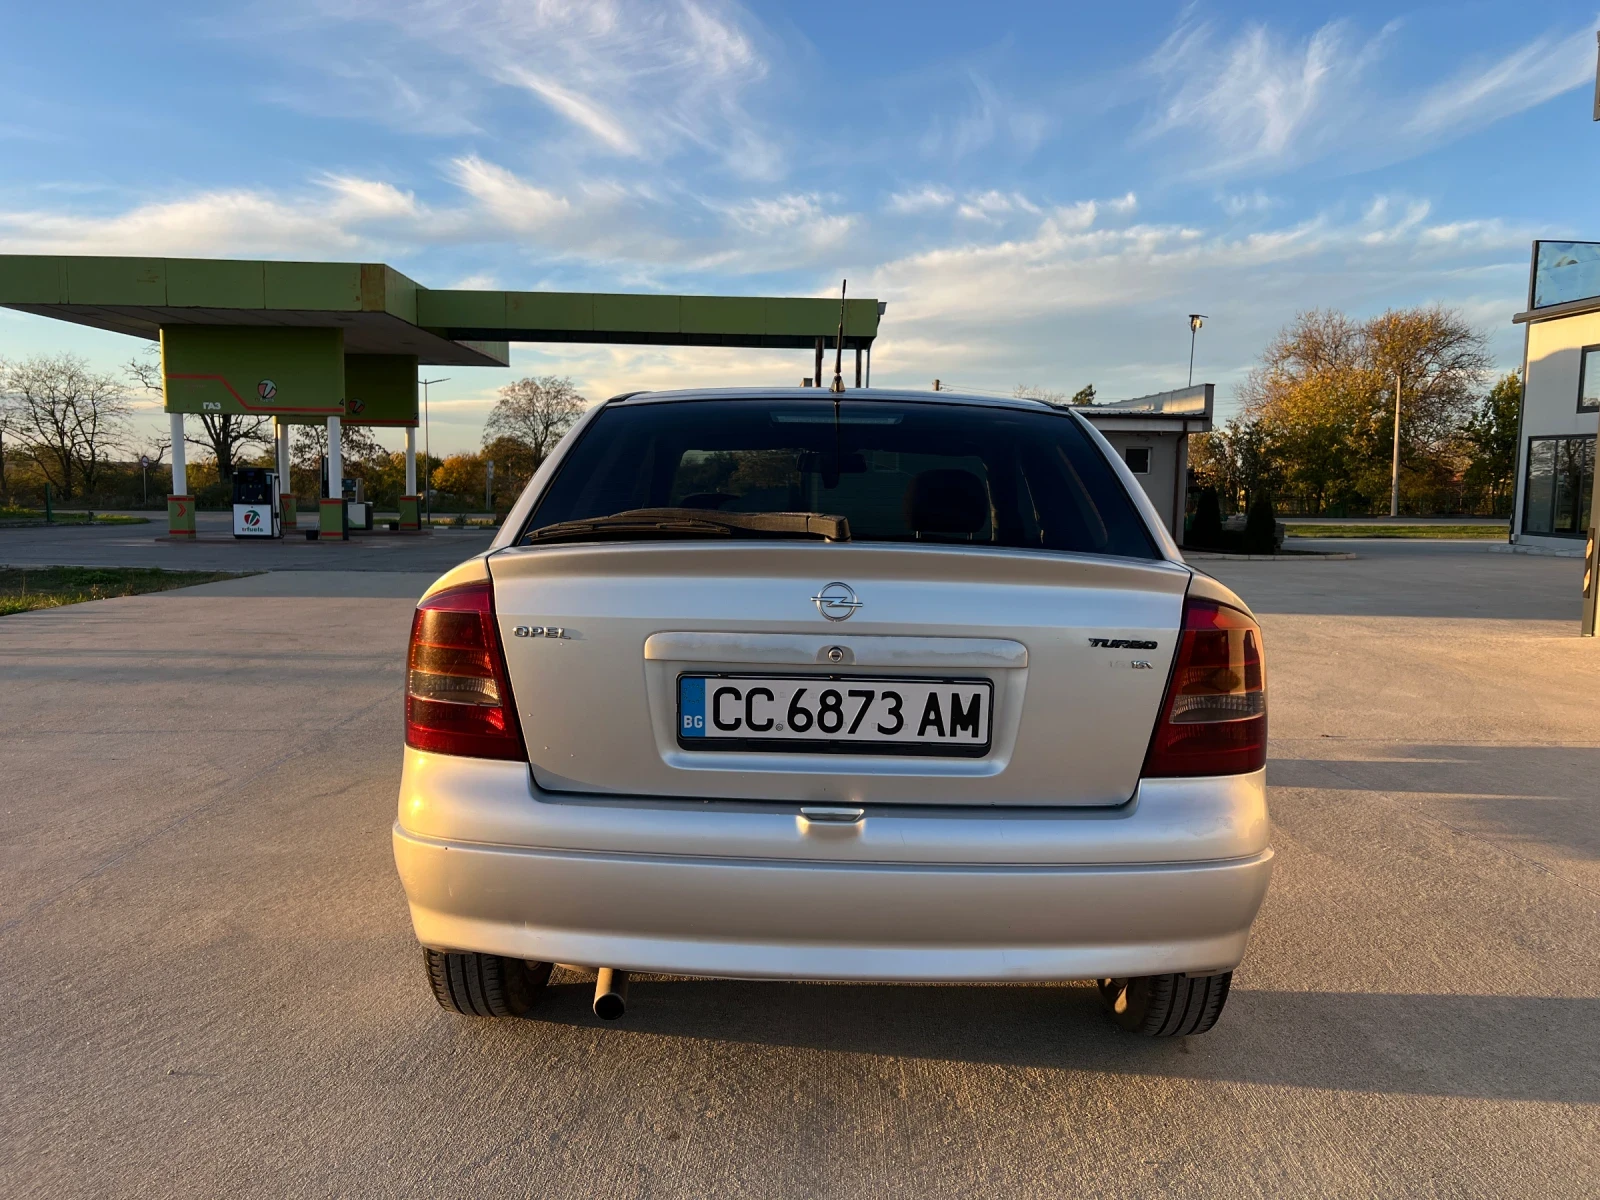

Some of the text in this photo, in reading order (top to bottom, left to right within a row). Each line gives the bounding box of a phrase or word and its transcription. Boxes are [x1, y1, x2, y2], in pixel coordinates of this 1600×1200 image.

[203, 402, 221, 410] ГАЗ
[512, 625, 572, 640] OPEL
[1088, 637, 1158, 650] TURBO
[712, 686, 982, 738] CC 6873 AM
[683, 715, 703, 729] BG
